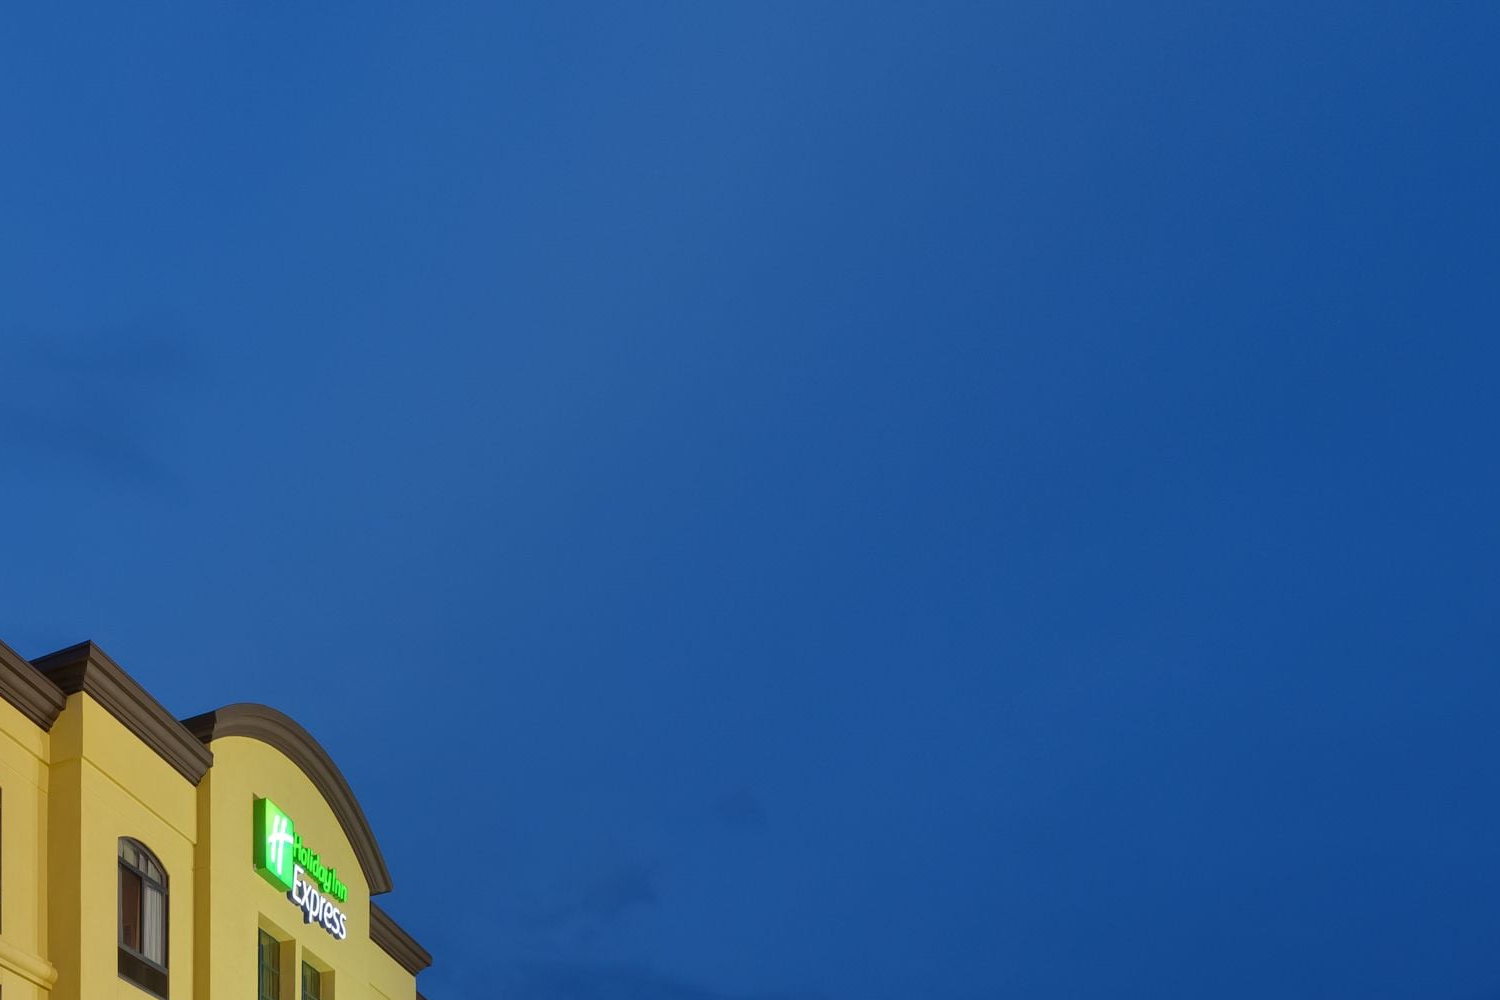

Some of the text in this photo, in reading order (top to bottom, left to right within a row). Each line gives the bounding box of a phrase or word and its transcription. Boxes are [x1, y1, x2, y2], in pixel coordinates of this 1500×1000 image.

[292, 864, 347, 939] Express
[293, 832, 348, 902] Holiday Inn
